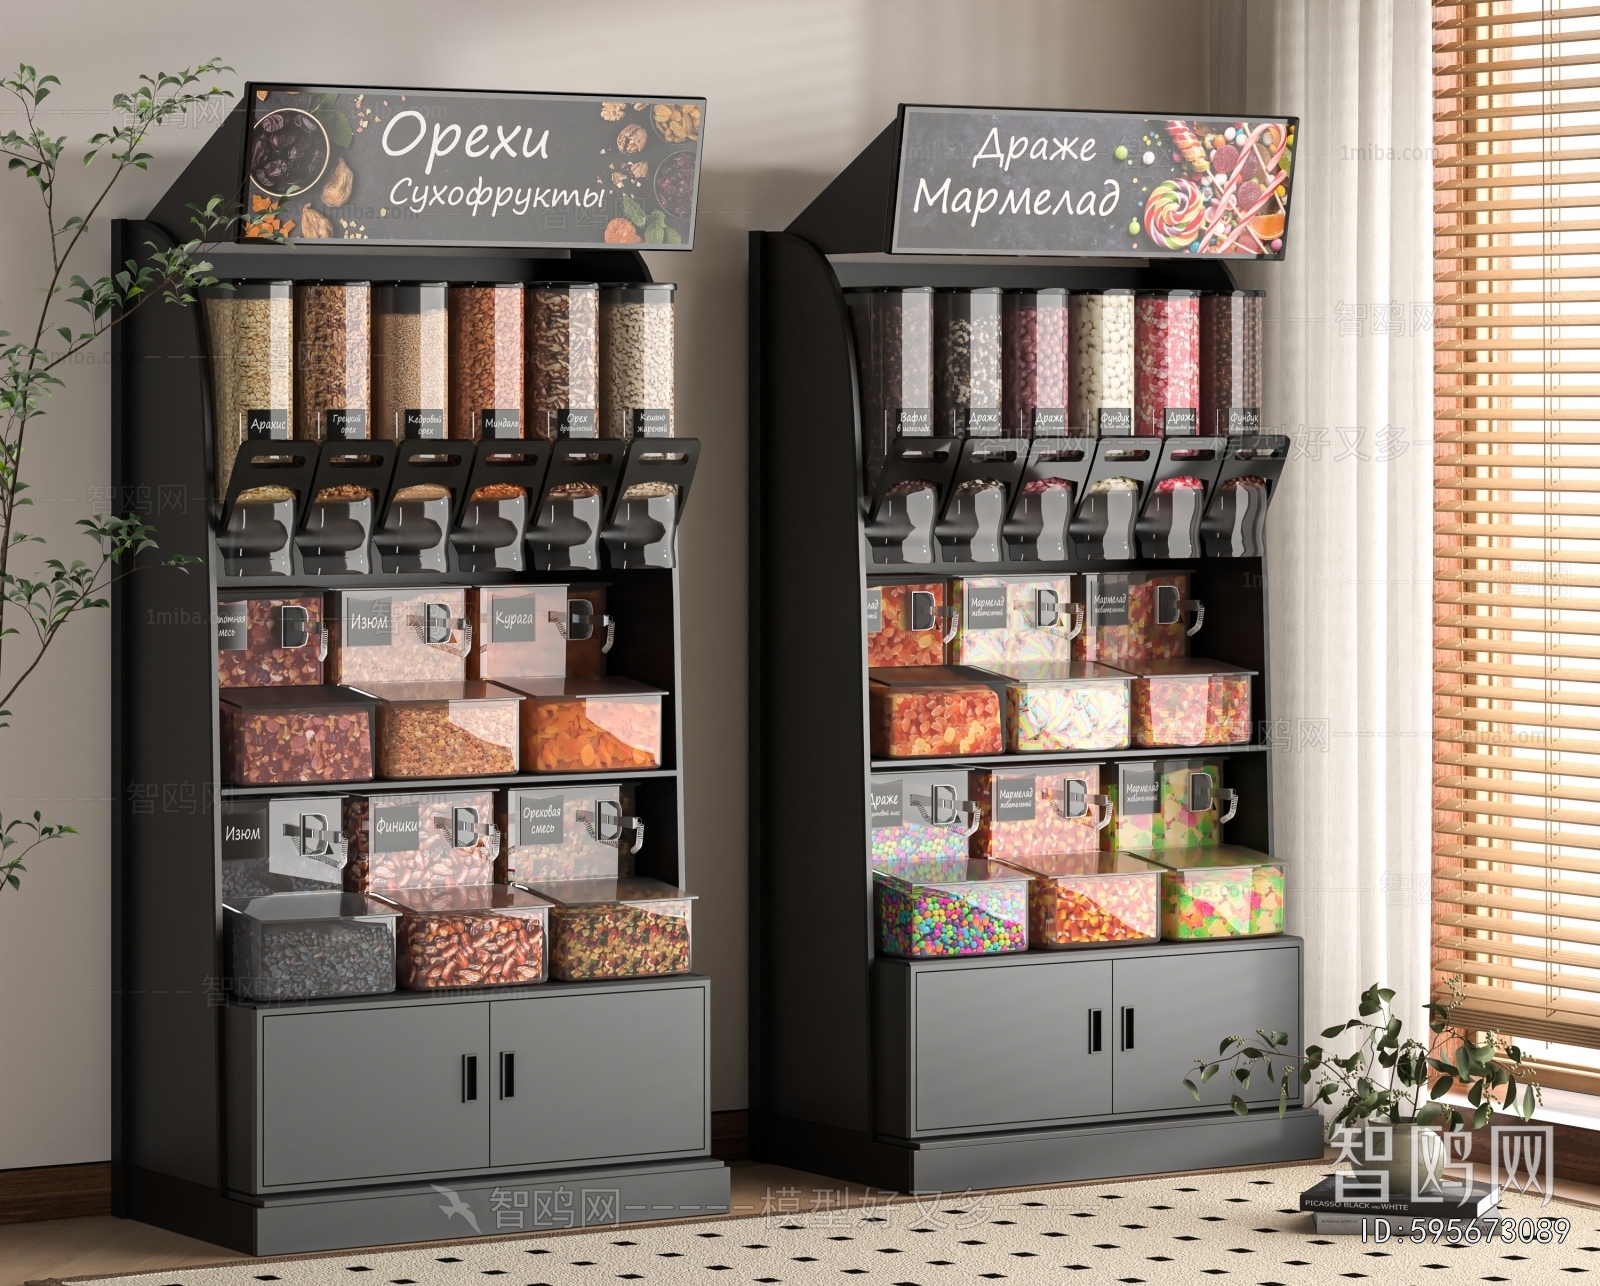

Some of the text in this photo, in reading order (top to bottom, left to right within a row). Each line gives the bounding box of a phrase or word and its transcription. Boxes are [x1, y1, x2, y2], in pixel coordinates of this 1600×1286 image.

[381, 109, 550, 175] Орехи
[972, 127, 1097, 170] Драже
[390, 176, 605, 217] Сухофрукты
[913, 177, 1120, 226] Мармелад
[332, 414, 362, 425] Грецкий
[408, 414, 442, 427] Кедровый
[485, 417, 519, 428] Миндаль
[567, 413, 588, 426] Орех
[640, 412, 666, 421] Кешью
[900, 411, 928, 425] Вафля
[969, 412, 997, 425] Драже
[1034, 412, 1064, 426] Драже
[1100, 411, 1130, 425] Фундук
[1167, 412, 1195, 425] Драже
[1230, 411, 1259, 425] Фундук
[250, 418, 286, 433] Арахис
[340, 426, 357, 436] орех
[417, 427, 434, 437] орех
[637, 424, 668, 435] жареный
[971, 596, 1005, 610] Мармелад
[1094, 593, 1126, 607] Мармелад
[351, 613, 388, 630] Изюм
[495, 611, 533, 630] Курага
[1127, 776, 1159, 796] Мармелад
[1000, 787, 1034, 802] Мармелад
[523, 805, 562, 822] Ореховая
[376, 817, 418, 834] Финики
[531, 824, 555, 834] смесь
[225, 825, 261, 841] Изюм
[1305, 1199, 1342, 1209] PICASSO
[1343, 1200, 1370, 1209] BLACK
[1381, 1202, 1409, 1211] WHITE
